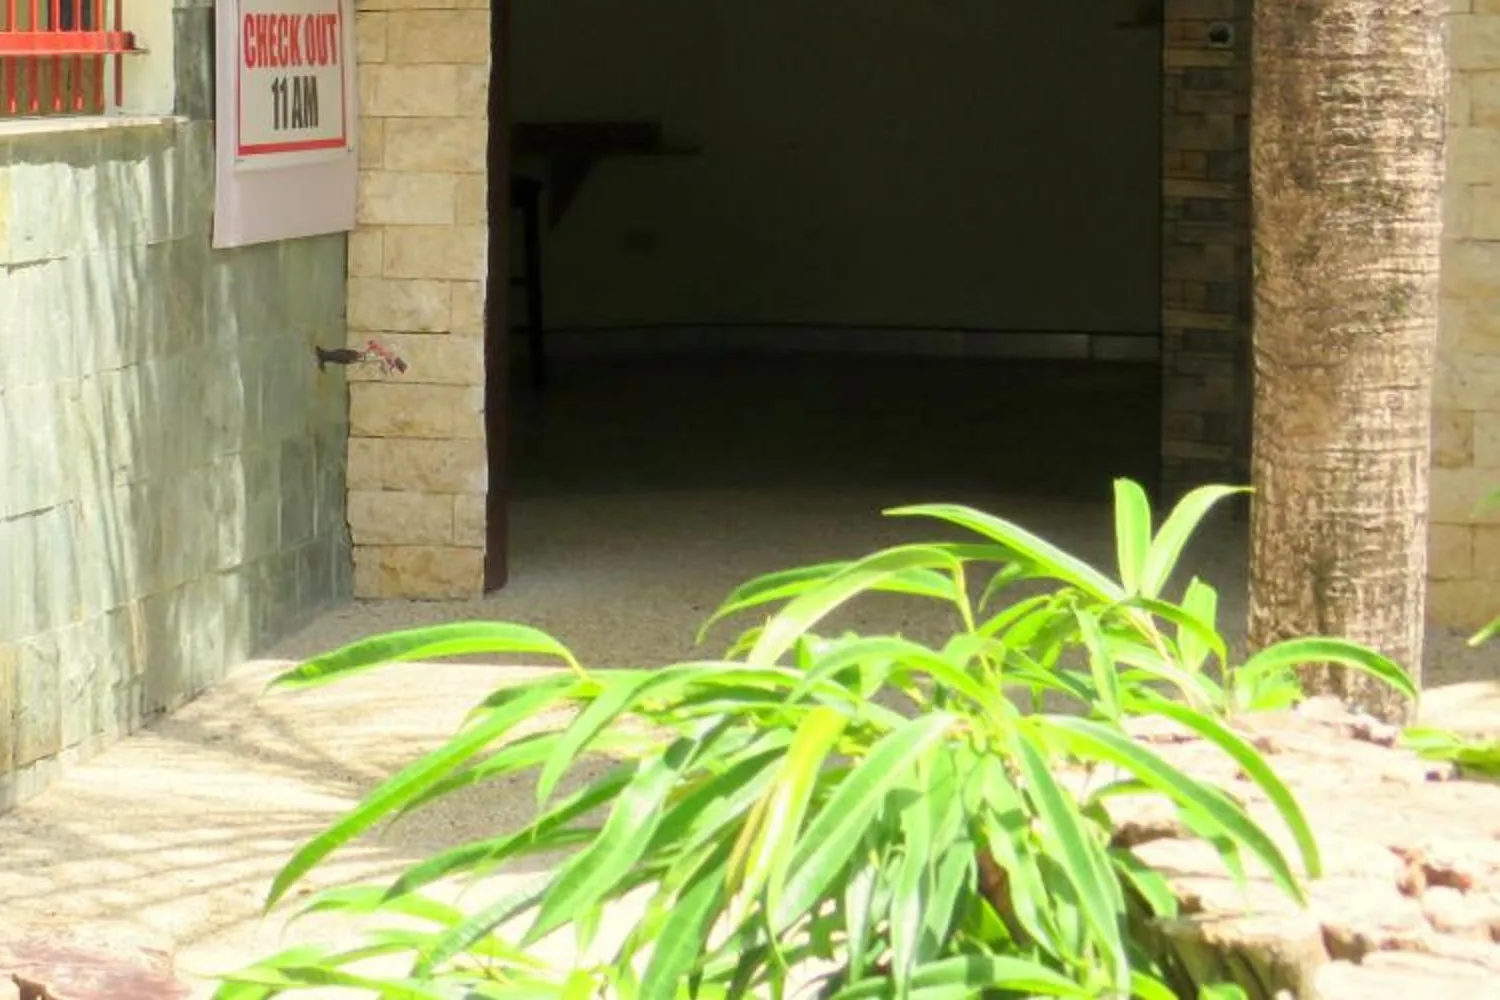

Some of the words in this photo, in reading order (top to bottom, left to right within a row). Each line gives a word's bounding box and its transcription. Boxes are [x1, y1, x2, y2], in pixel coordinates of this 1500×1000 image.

[243, 13, 302, 69] CHECK
[304, 12, 337, 67] OUT
[271, 76, 288, 131] 11
[291, 75, 318, 129] AM
